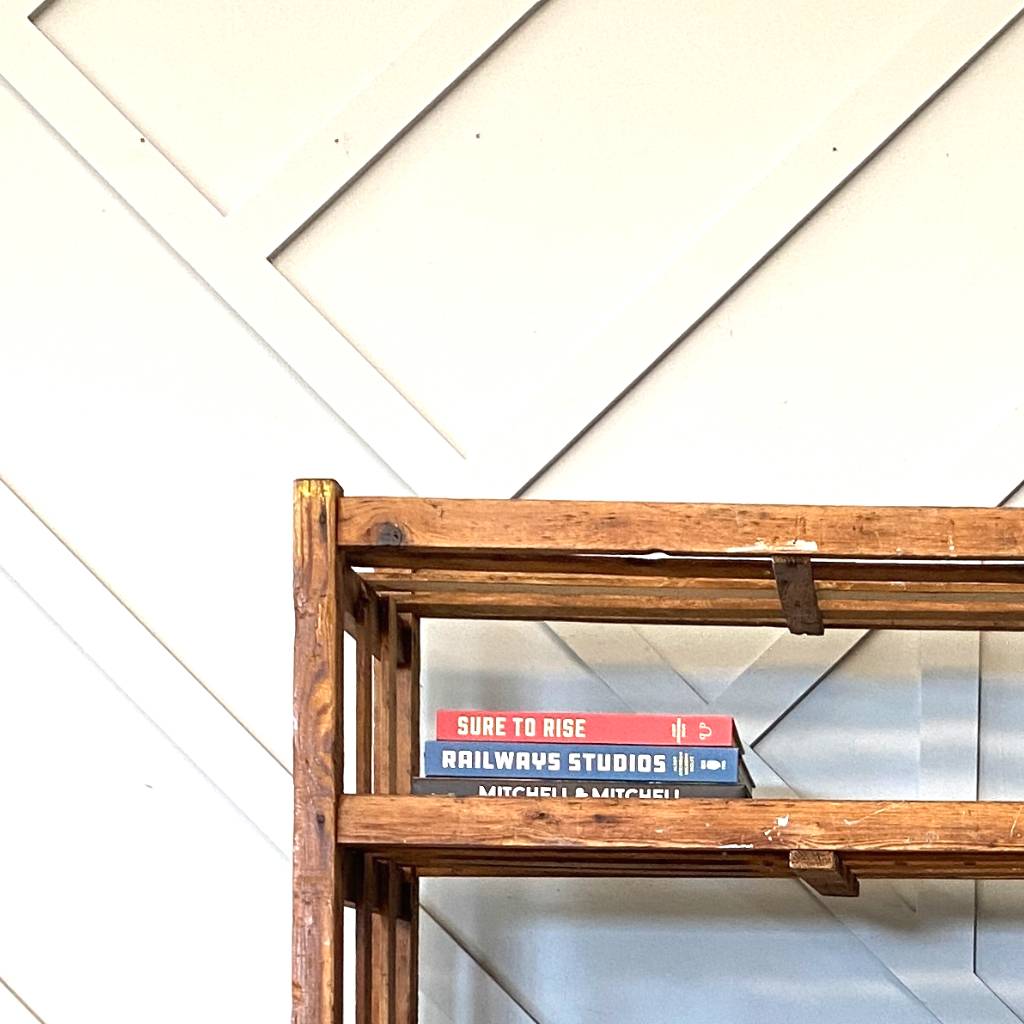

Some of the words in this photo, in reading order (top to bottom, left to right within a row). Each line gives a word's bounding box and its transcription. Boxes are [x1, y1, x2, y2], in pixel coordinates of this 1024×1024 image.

[457, 717, 506, 736] SURE
[512, 717, 534, 736] TO
[543, 719, 586, 738] RISE
[441, 750, 560, 770] RAILWAYS
[568, 753, 666, 773] STUDIOS
